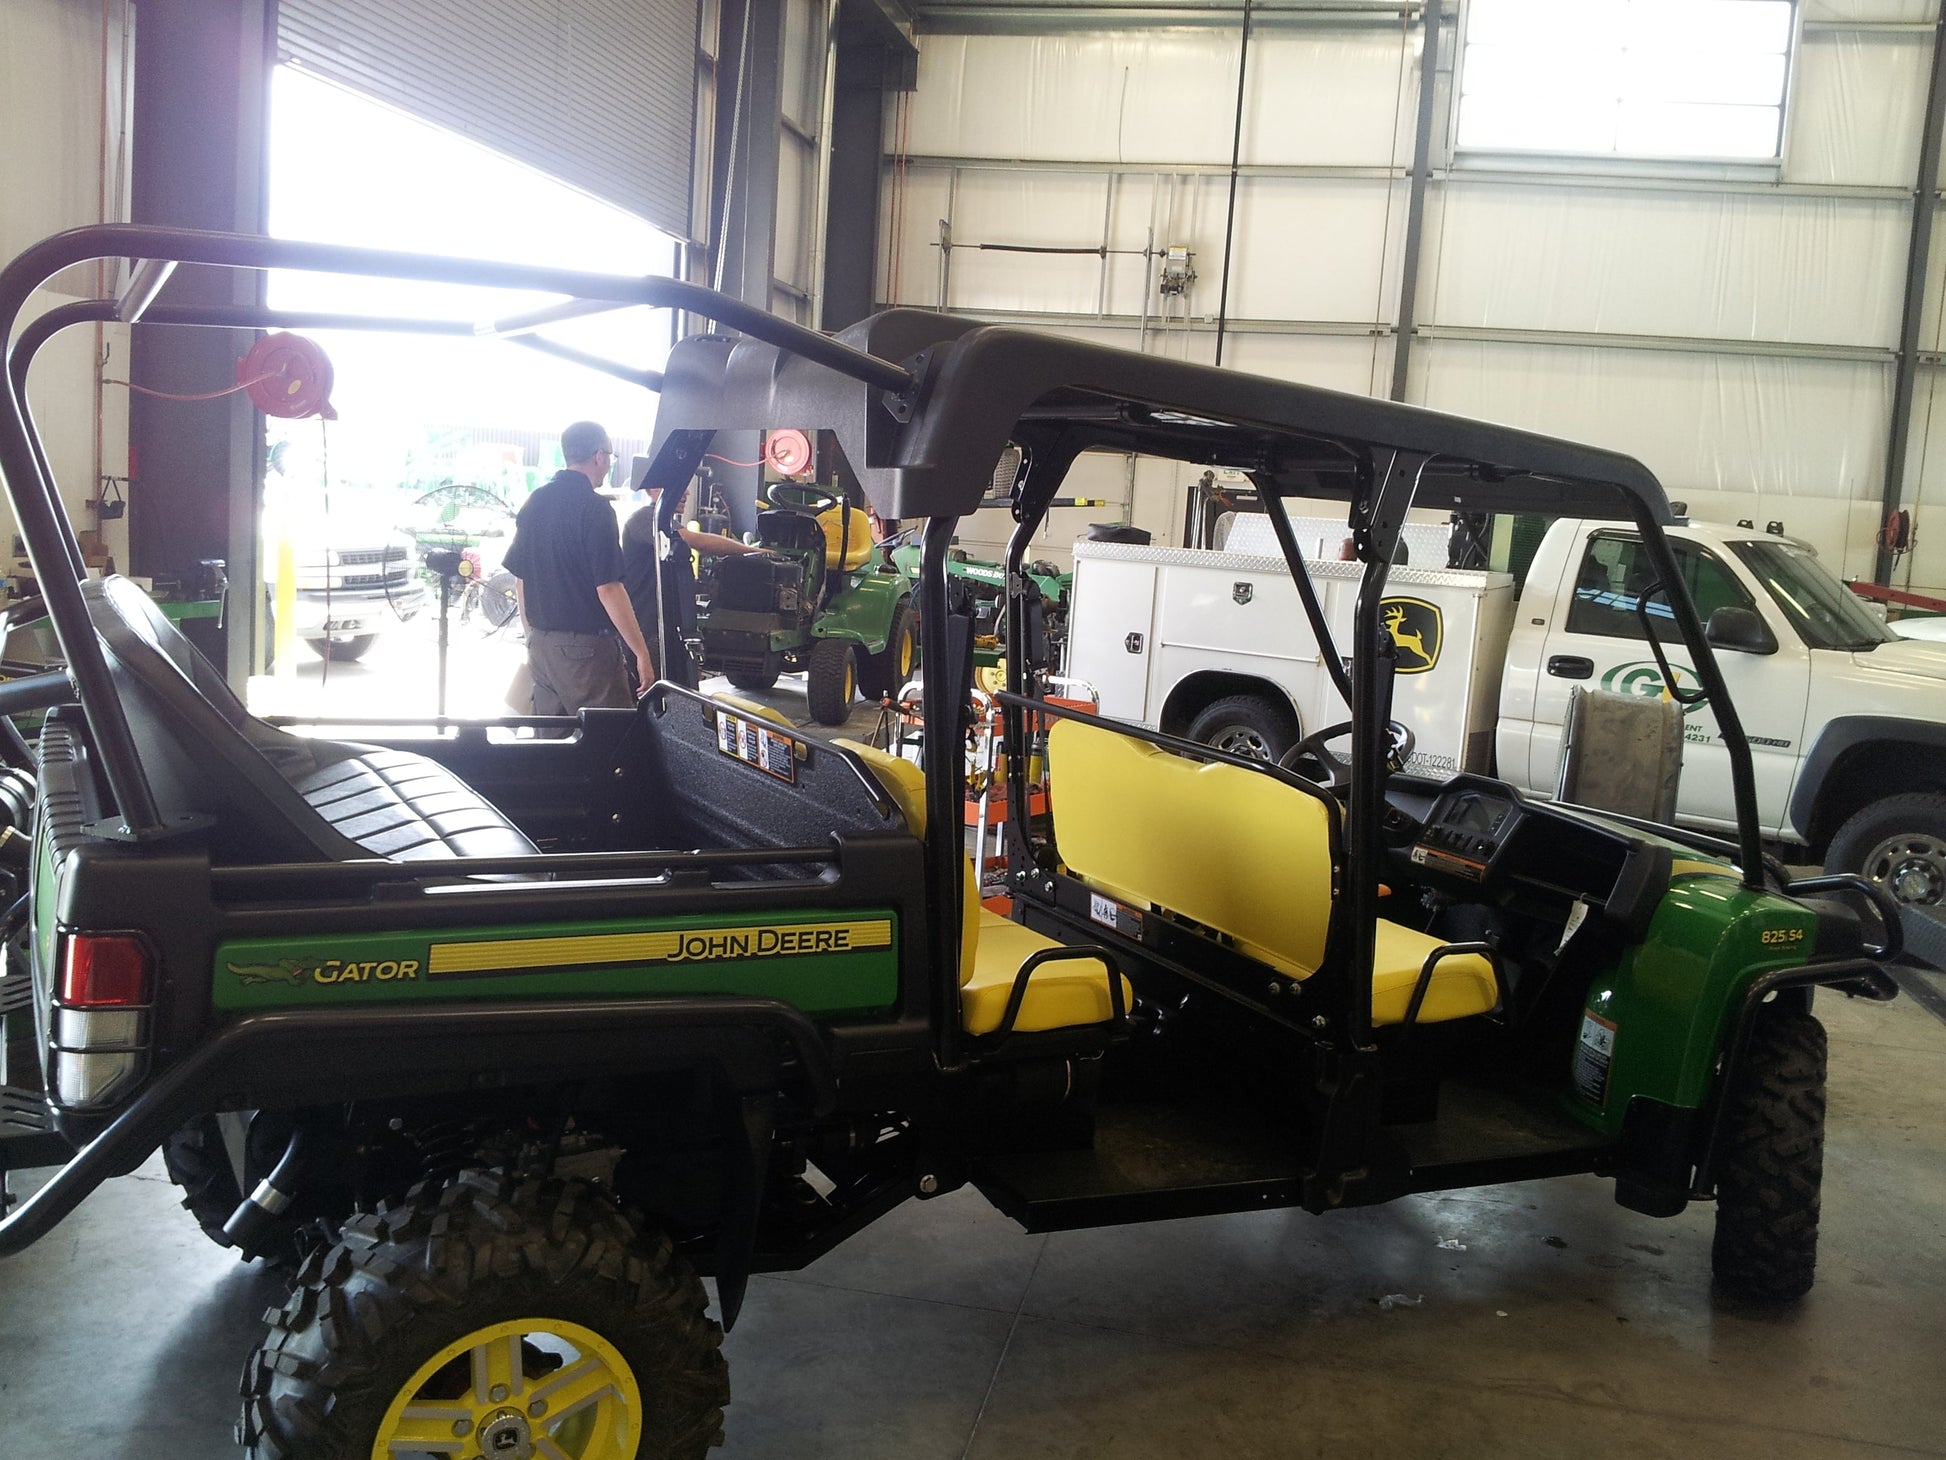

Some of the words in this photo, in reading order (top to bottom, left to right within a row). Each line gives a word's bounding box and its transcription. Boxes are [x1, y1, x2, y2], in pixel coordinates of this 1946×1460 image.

[966, 566, 993, 578] WOODS
[1409, 751, 1457, 770] DOT-122281
[667, 933, 750, 960] JOHN
[757, 928, 851, 954] DEERE
[1788, 928, 1804, 942] S4
[314, 960, 420, 983] GATOR
